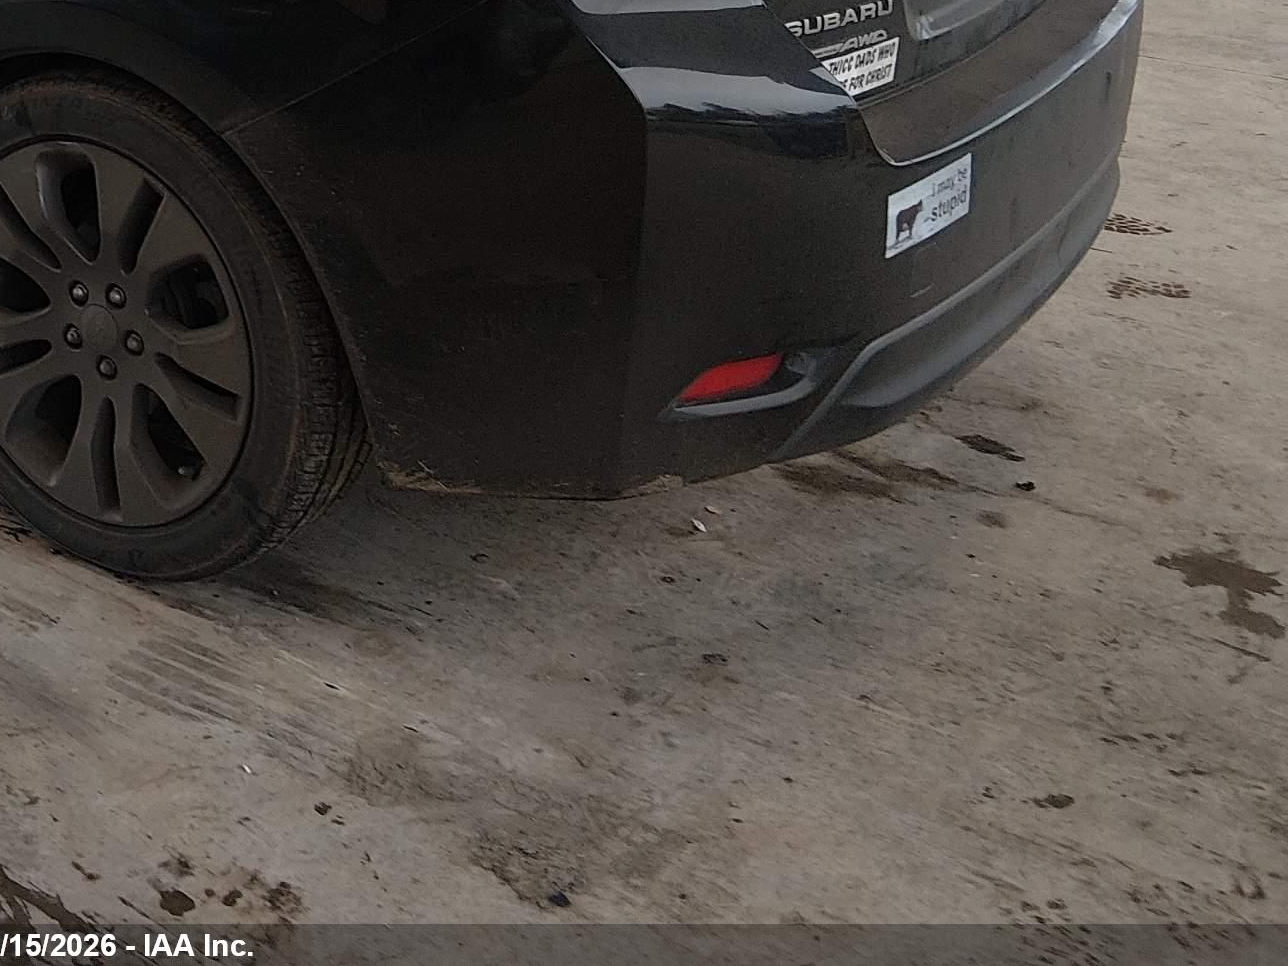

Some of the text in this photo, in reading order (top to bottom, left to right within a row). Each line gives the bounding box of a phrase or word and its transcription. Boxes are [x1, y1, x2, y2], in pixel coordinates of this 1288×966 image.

[839, 29, 888, 52] AWD
[829, 56, 854, 75] THICC
[854, 48, 877, 70] DADS
[848, 73, 865, 91] FOR
[865, 63, 893, 86] CHRIST
[931, 184, 967, 222] stupid
